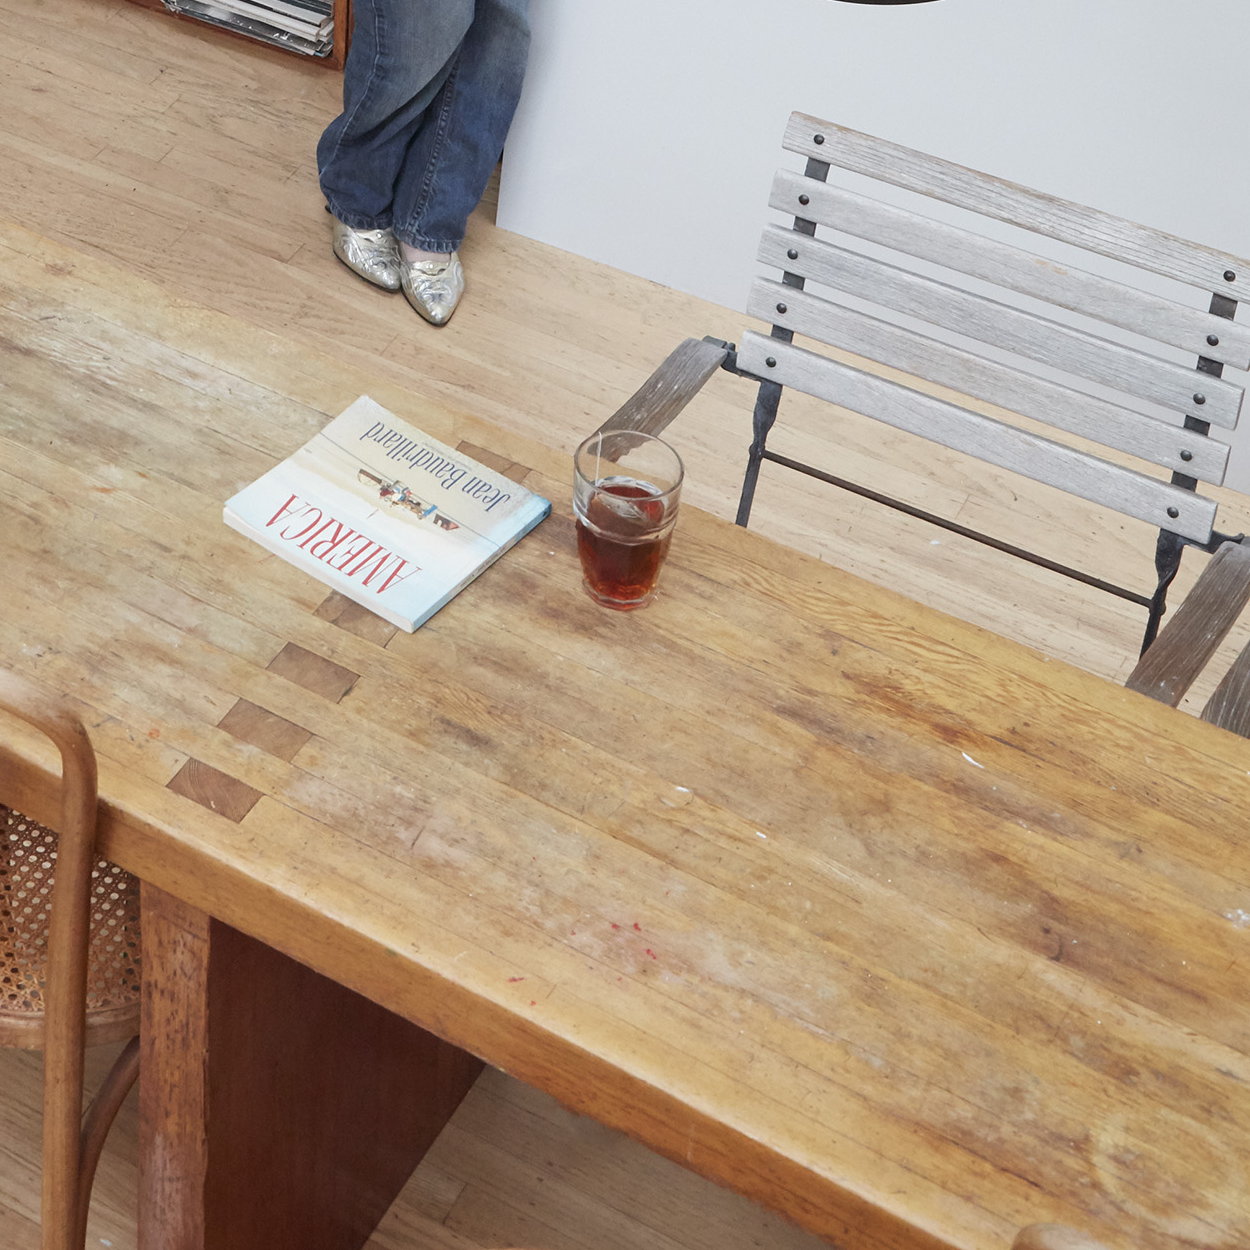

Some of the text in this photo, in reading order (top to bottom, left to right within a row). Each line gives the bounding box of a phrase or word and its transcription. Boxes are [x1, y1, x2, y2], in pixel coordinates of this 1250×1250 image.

[359, 421, 511, 512] Jean Baudrillard
[265, 493, 422, 595] AMERICA
